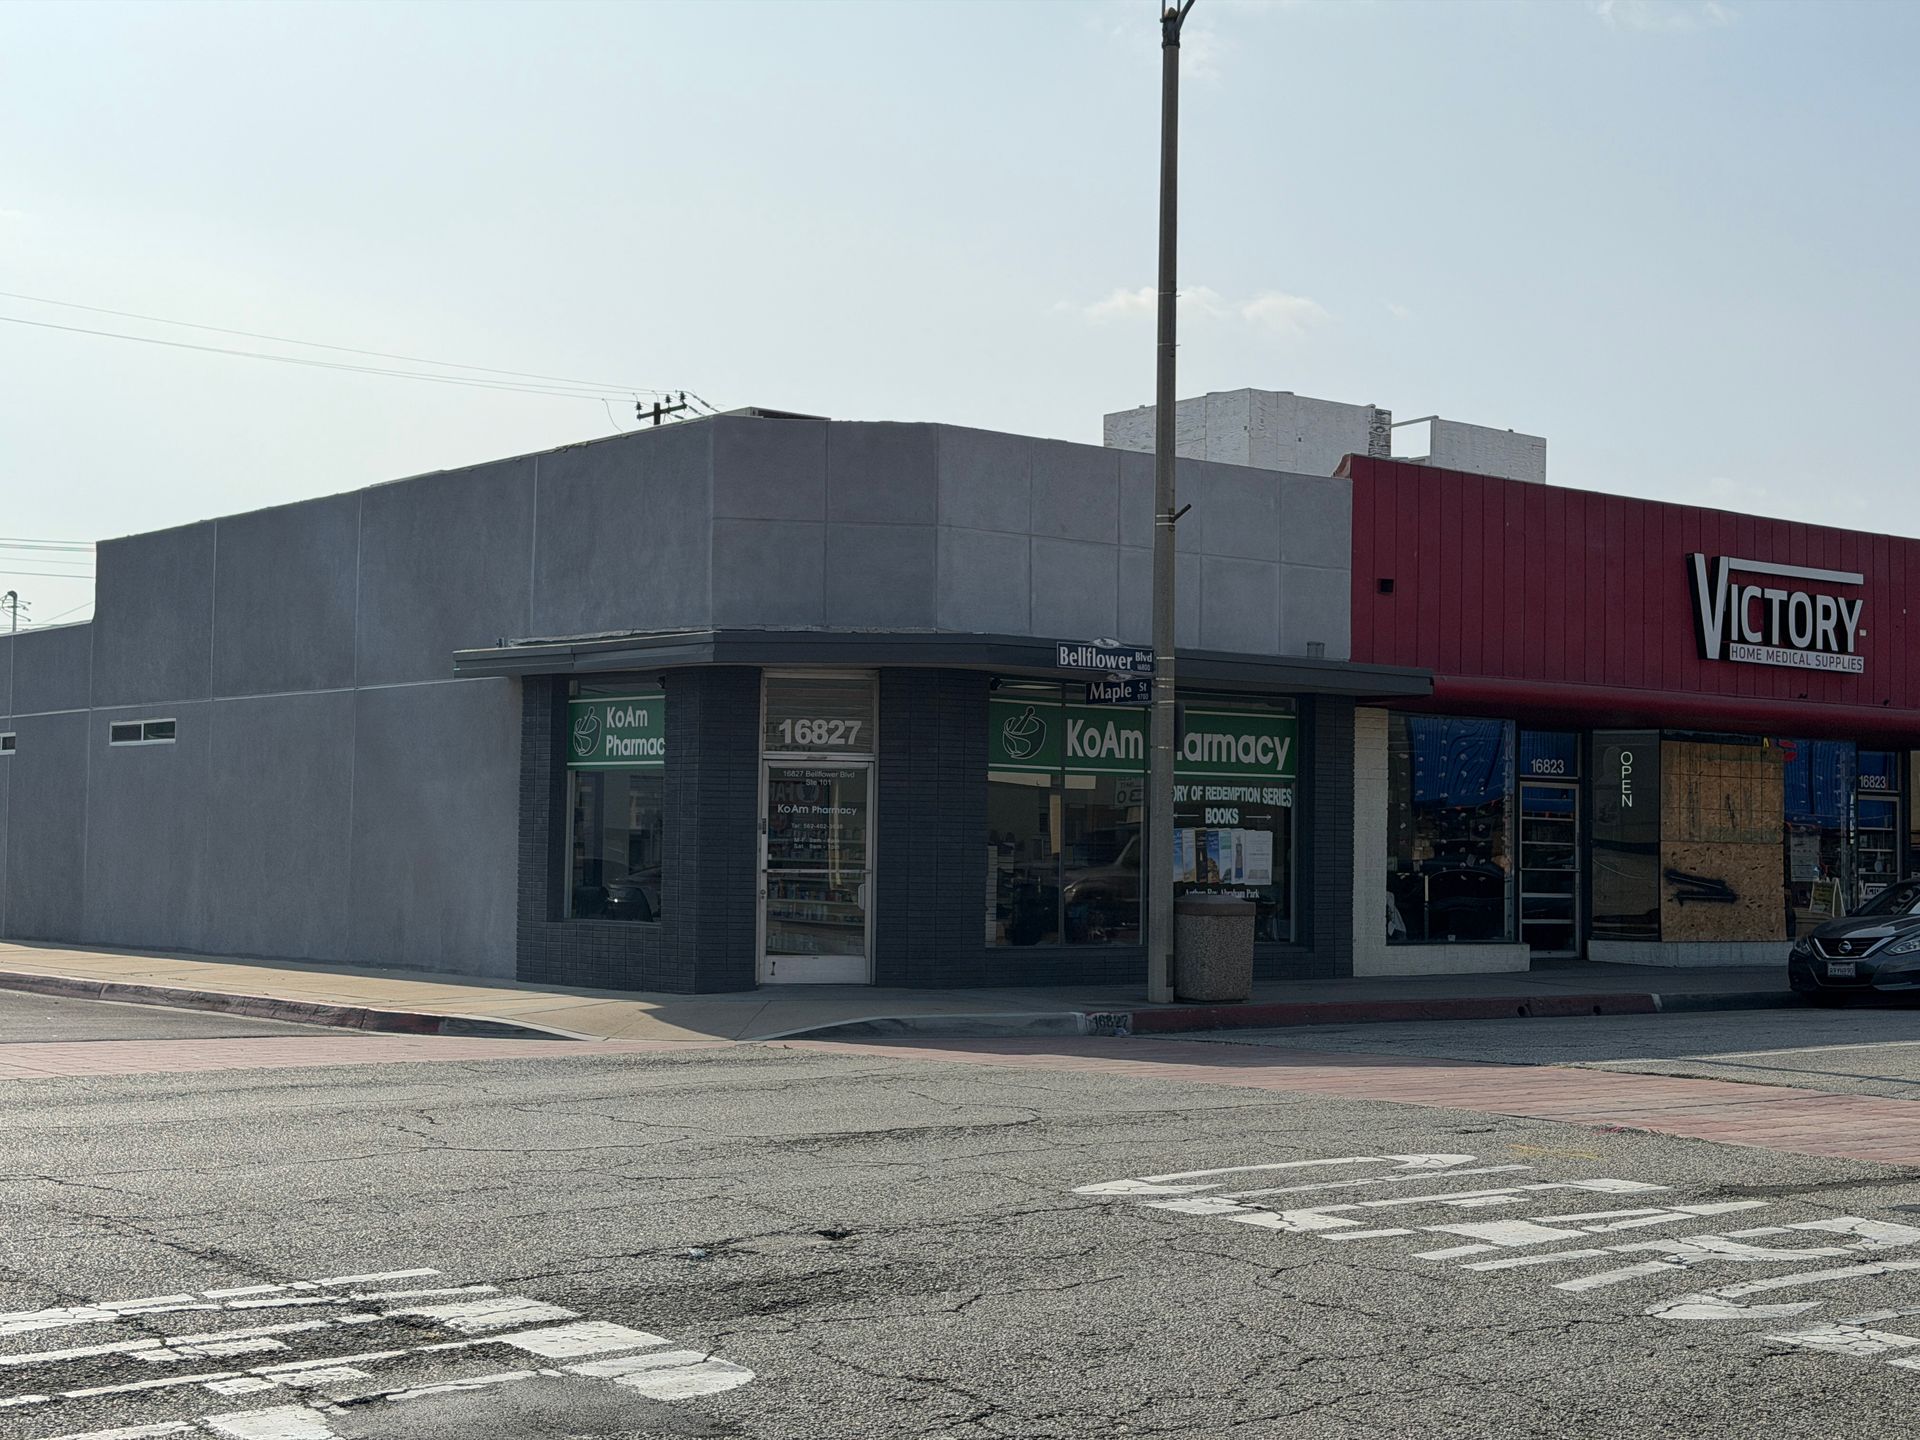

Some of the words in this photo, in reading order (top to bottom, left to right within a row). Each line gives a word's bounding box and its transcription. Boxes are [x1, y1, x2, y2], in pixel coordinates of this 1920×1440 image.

[1692, 552, 1864, 660] VICTORY
[1059, 646, 1133, 670] Bellflower
[1135, 651, 1153, 663] Blvd
[1731, 645, 1762, 664] HOME
[1766, 649, 1811, 667] MEDICAL
[1815, 654, 1863, 671] SUPPLIES
[1089, 682, 1132, 703] Maple
[1138, 682, 1147, 692] St
[606, 705, 649, 728] KoAm
[779, 719, 862, 745] 16827
[605, 734, 666, 756] Pharmac
[1066, 718, 1144, 760] KoAm
[1176, 731, 1291, 771] armacy
[783, 770, 804, 778] 16827
[805, 770, 838, 778] Bellflower
[1531, 758, 1565, 774] 16823
[1620, 751, 1633, 808] OPEN
[1858, 775, 1886, 789] 16823
[1190, 785, 1203, 801] OF
[1205, 785, 1261, 804] REDEMPTION
[1262, 787, 1293, 808] SERIES
[777, 804, 809, 815] KoAm
[811, 805, 857, 816] Pharmacy
[1204, 807, 1239, 825] BOOKS
[1246, 888, 1260, 899] Park
